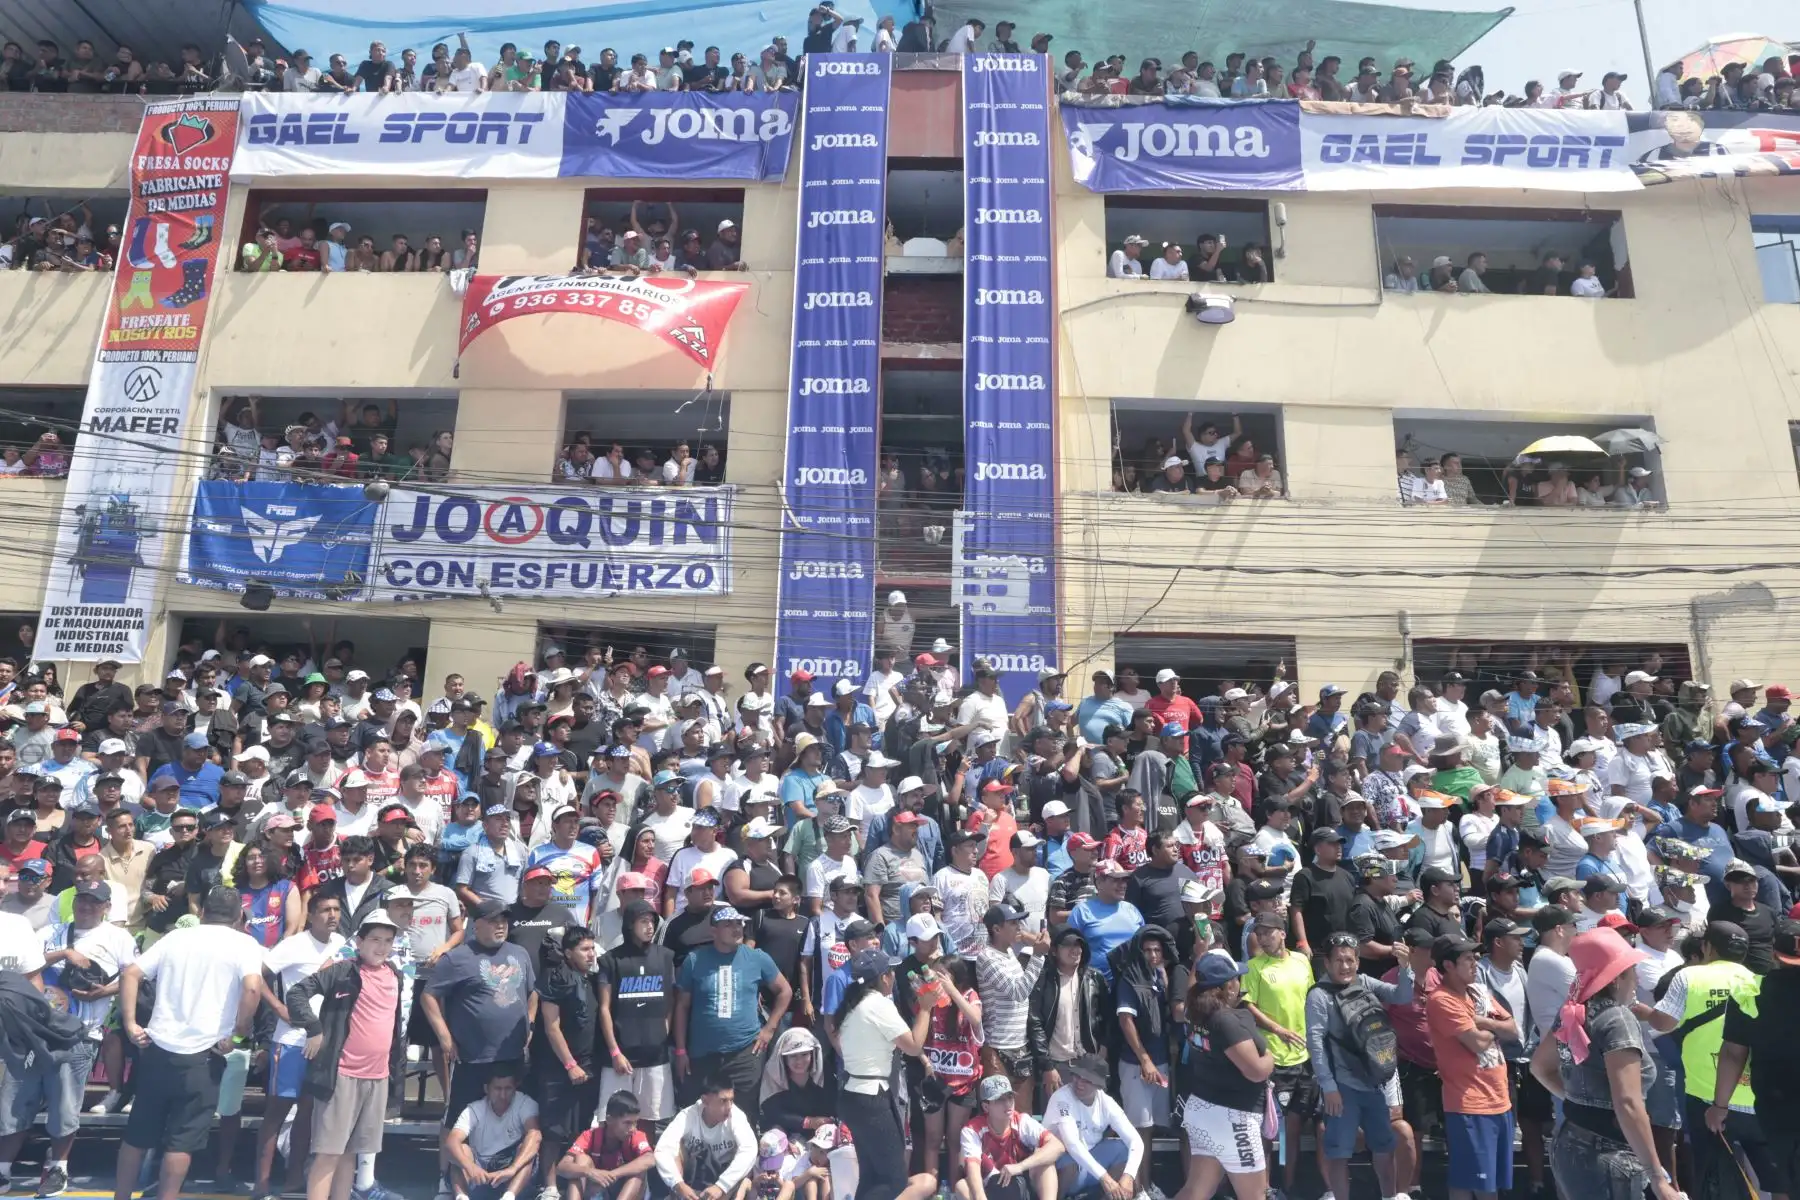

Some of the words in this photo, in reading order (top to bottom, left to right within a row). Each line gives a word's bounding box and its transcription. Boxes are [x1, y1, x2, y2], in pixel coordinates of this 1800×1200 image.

[148, 103, 184, 115] PRODUCTO
[185, 102, 204, 112] 100%
[206, 101, 238, 111] PERUANO
[248, 112, 360, 146] GAEL
[379, 112, 544, 145] SPORT
[640, 107, 792, 145] Joma
[1114, 121, 1270, 162] Joma
[1320, 133, 1442, 166] GAEL
[1461, 133, 1625, 168] SPORT
[138, 156, 180, 170] FRESA
[184, 157, 229, 171] SOCKS
[141, 174, 222, 195] FABRICANTE
[148, 199, 166, 212] DE
[168, 192, 217, 211] MEDIAS
[488, 281, 554, 302] AGENTES
[513, 293, 558, 309] 936
[563, 292, 612, 308] 337
[108, 326, 197, 343] NOSOTROS
[100, 350, 139, 362] PRODUCTO
[141, 350, 162, 362] 100%
[163, 351, 197, 363] PERUANO
[94, 406, 152, 414] CORPORACIÓN
[90, 416, 179, 434] MAFER
[390, 496, 718, 549] JOAQUIN
[386, 559, 476, 588] CON
[490, 561, 714, 590] ESFUERZO
[51, 606, 144, 618] DISTRIBUIDOR
[45, 617, 61, 628] DE
[63, 618, 144, 630] MAQUINARIA
[54, 630, 129, 642] INDUSTRIAL
[55, 642, 71, 653] DE
[73, 642, 124, 654] MEDIAS
[520, 919, 552, 927] Columbia
[620, 975, 663, 993] MAGIC
[1232, 1122, 1248, 1132] IT
[1234, 1132, 1250, 1148] DO
[1237, 1148, 1256, 1167] JUST
